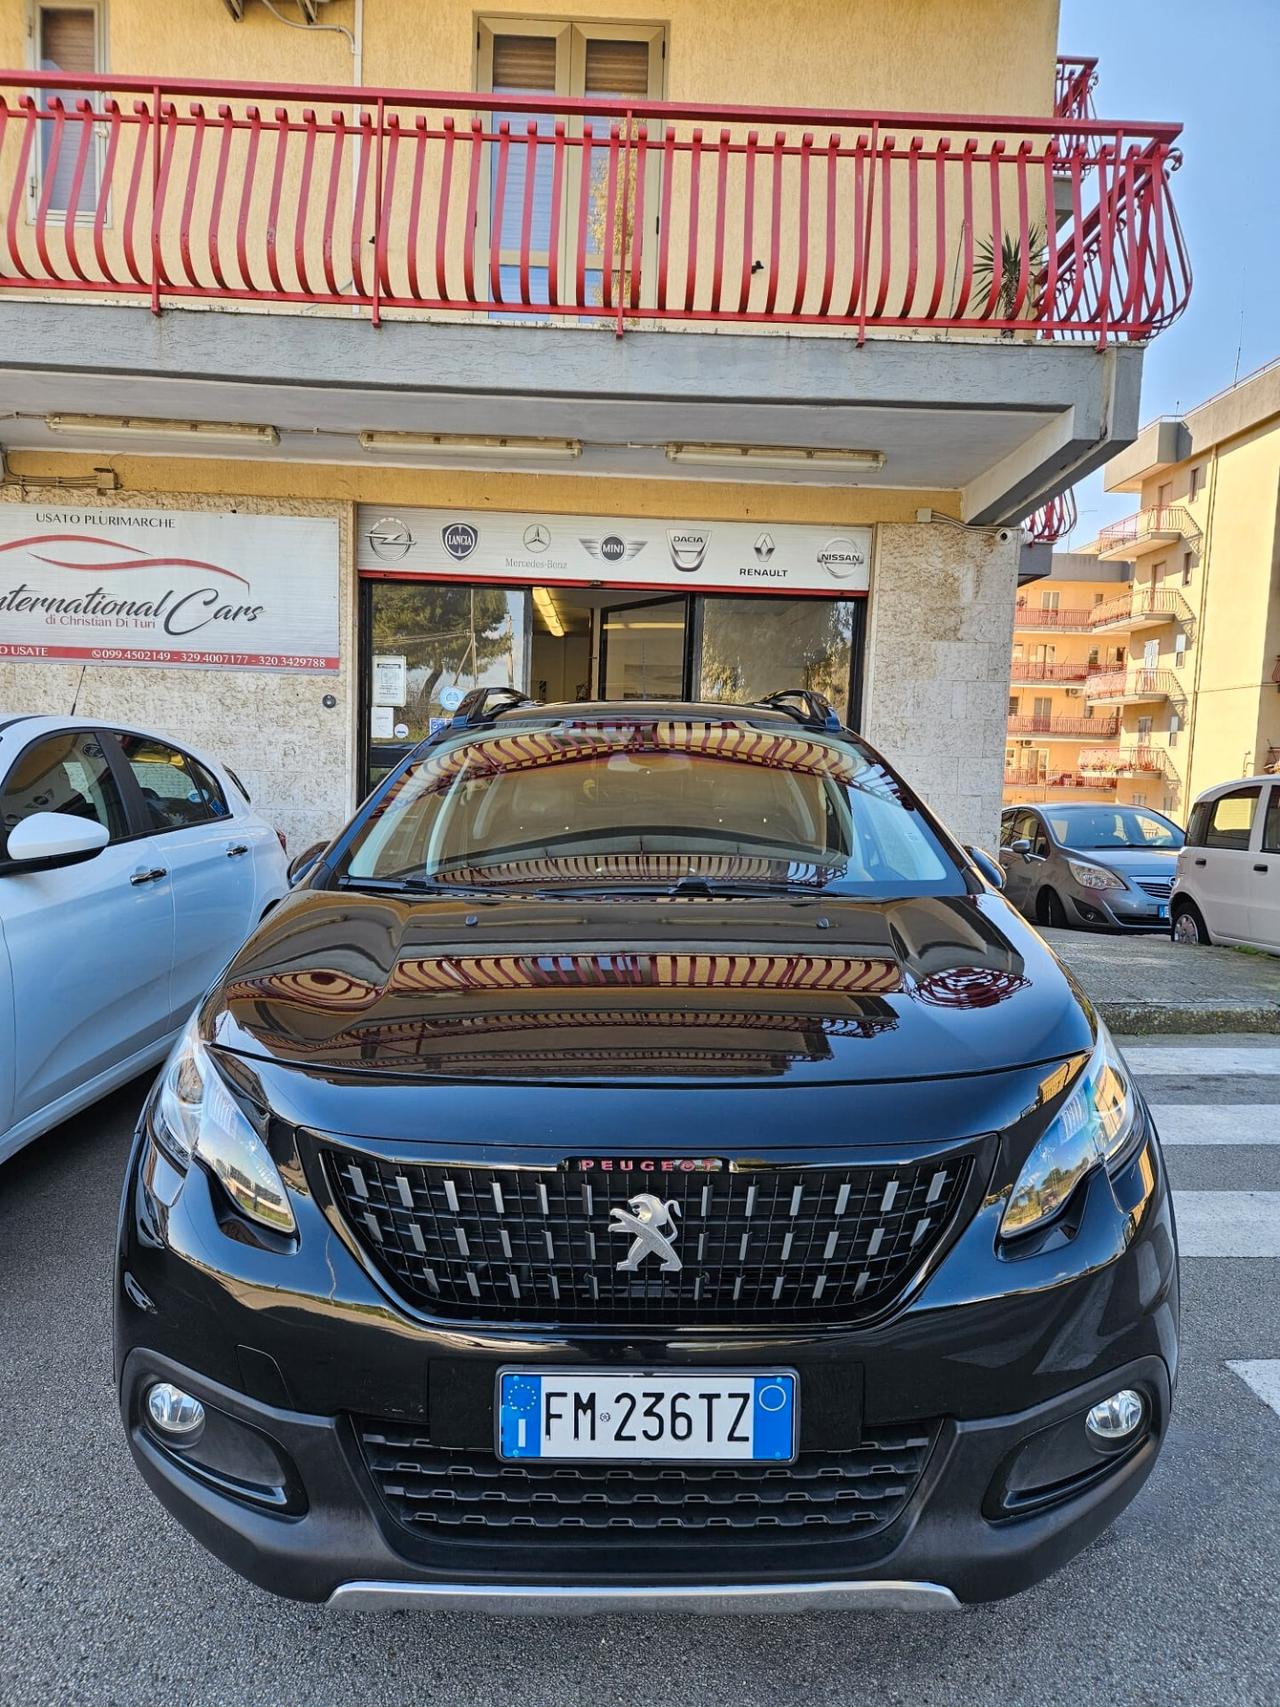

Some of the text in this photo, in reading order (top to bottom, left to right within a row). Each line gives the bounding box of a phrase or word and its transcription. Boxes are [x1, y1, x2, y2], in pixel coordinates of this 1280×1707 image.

[36, 512, 176, 529] USATO PLURIMARCHE
[448, 534, 473, 546] LANCIA
[673, 535, 704, 544] DACIA
[601, 543, 625, 556] MINI
[505, 558, 568, 570] Mercedes-Benz
[821, 553, 860, 562] NISSAN
[739, 568, 788, 577] RENAULT
[163, 588, 266, 636] Cars
[45, 614, 156, 629] di Christian Di Turi
[11, 646, 49, 656] USATE
[101, 650, 171, 662] 099.4502149
[180, 653, 249, 665] 329.4007177
[258, 656, 326, 668] 320.3429788
[581, 1159, 714, 1172] PEUGEOT
[545, 1392, 751, 1442] FM 236TZ
